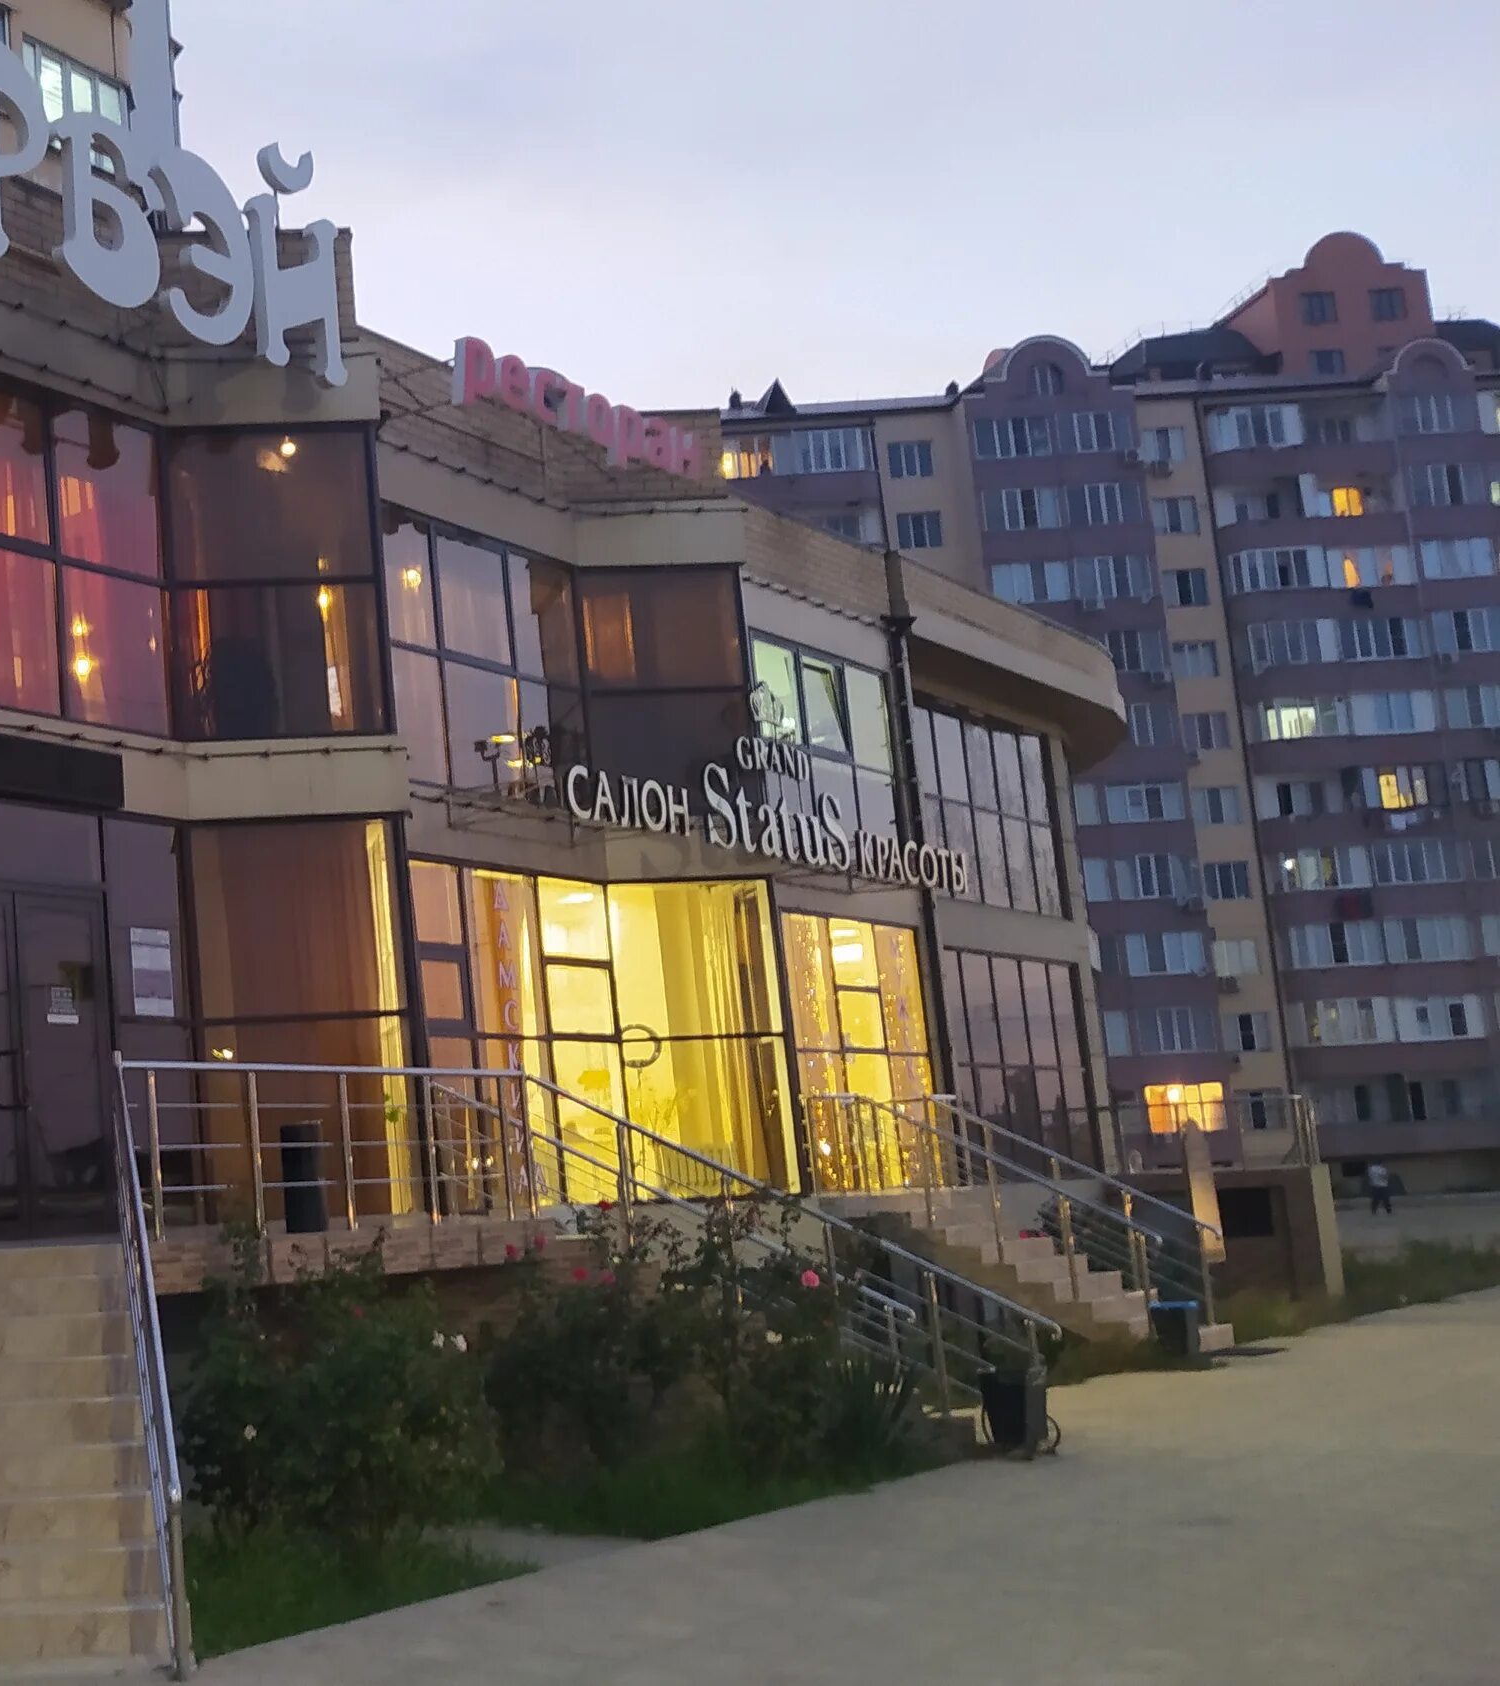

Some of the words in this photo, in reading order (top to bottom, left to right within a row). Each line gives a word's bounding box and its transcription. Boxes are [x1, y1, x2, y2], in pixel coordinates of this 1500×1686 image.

[451, 335, 702, 480] ресторан
[735, 735, 811, 781] GRAND
[566, 763, 692, 836] САЛОН
[854, 829, 970, 893] КРАСОТЫ
